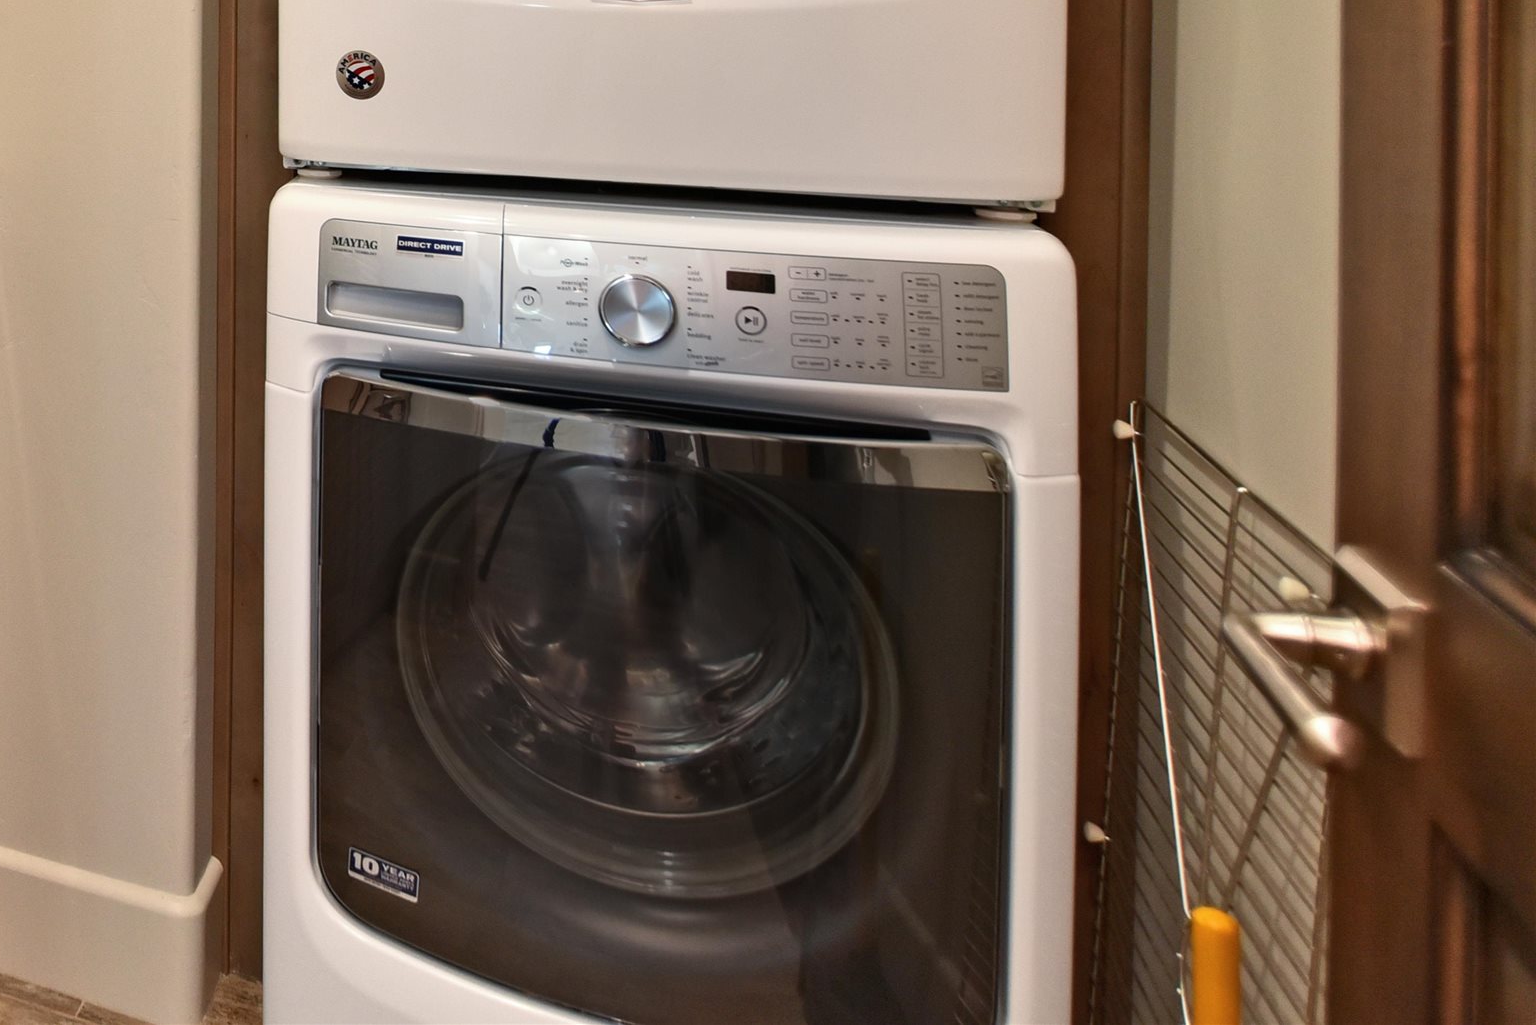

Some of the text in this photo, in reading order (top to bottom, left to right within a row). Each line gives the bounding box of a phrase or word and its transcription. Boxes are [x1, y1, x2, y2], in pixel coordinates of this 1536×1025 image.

[338, 52, 377, 75] AMERICA
[332, 236, 378, 250] MAYTAG
[398, 239, 462, 252] DIRECT DRIVE
[353, 851, 415, 882] 10 YEAR
